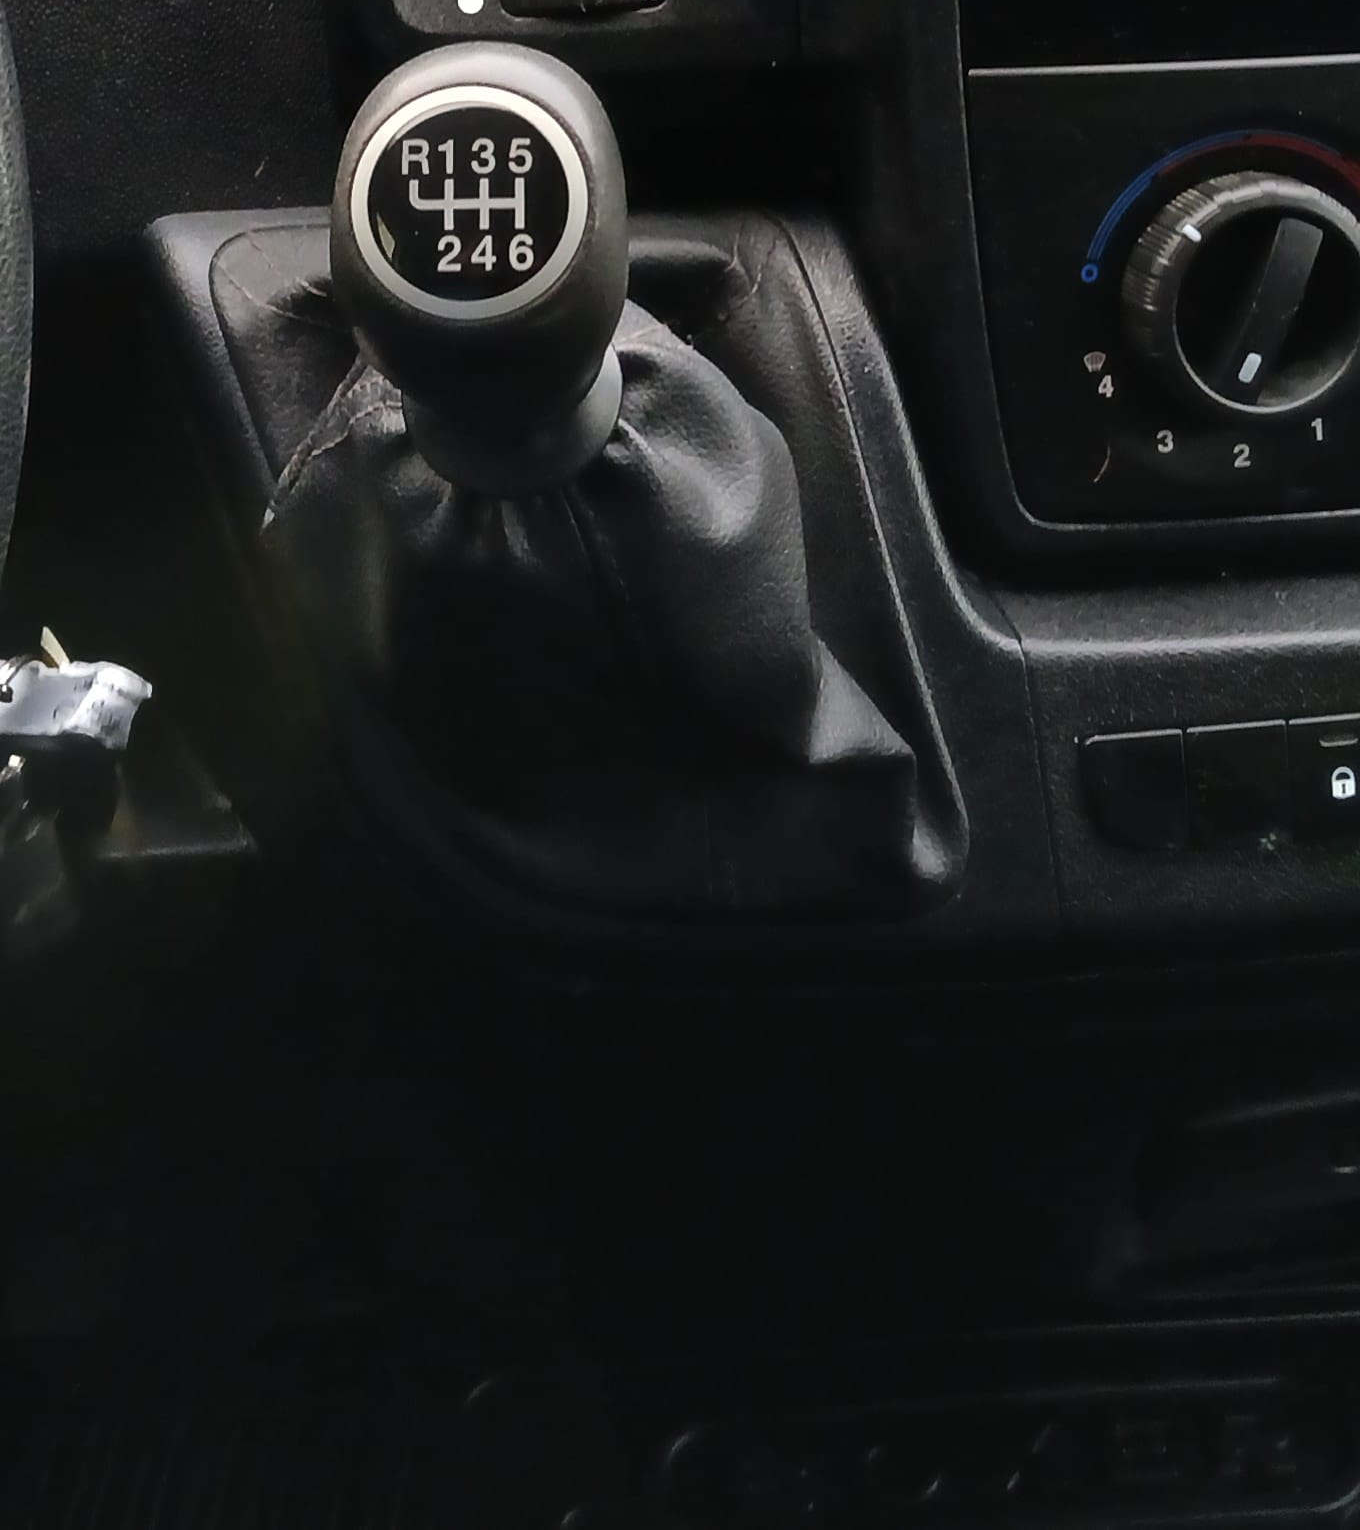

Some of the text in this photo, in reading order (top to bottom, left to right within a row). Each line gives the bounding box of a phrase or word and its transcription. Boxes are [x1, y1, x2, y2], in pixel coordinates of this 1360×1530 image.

[401, 137, 533, 176] R 1 3 5
[437, 233, 535, 273] 2 4 6
[1098, 374, 1115, 398] 4
[1156, 429, 1174, 454] 3
[1310, 417, 1323, 441] 1
[1232, 443, 1251, 468] 2
